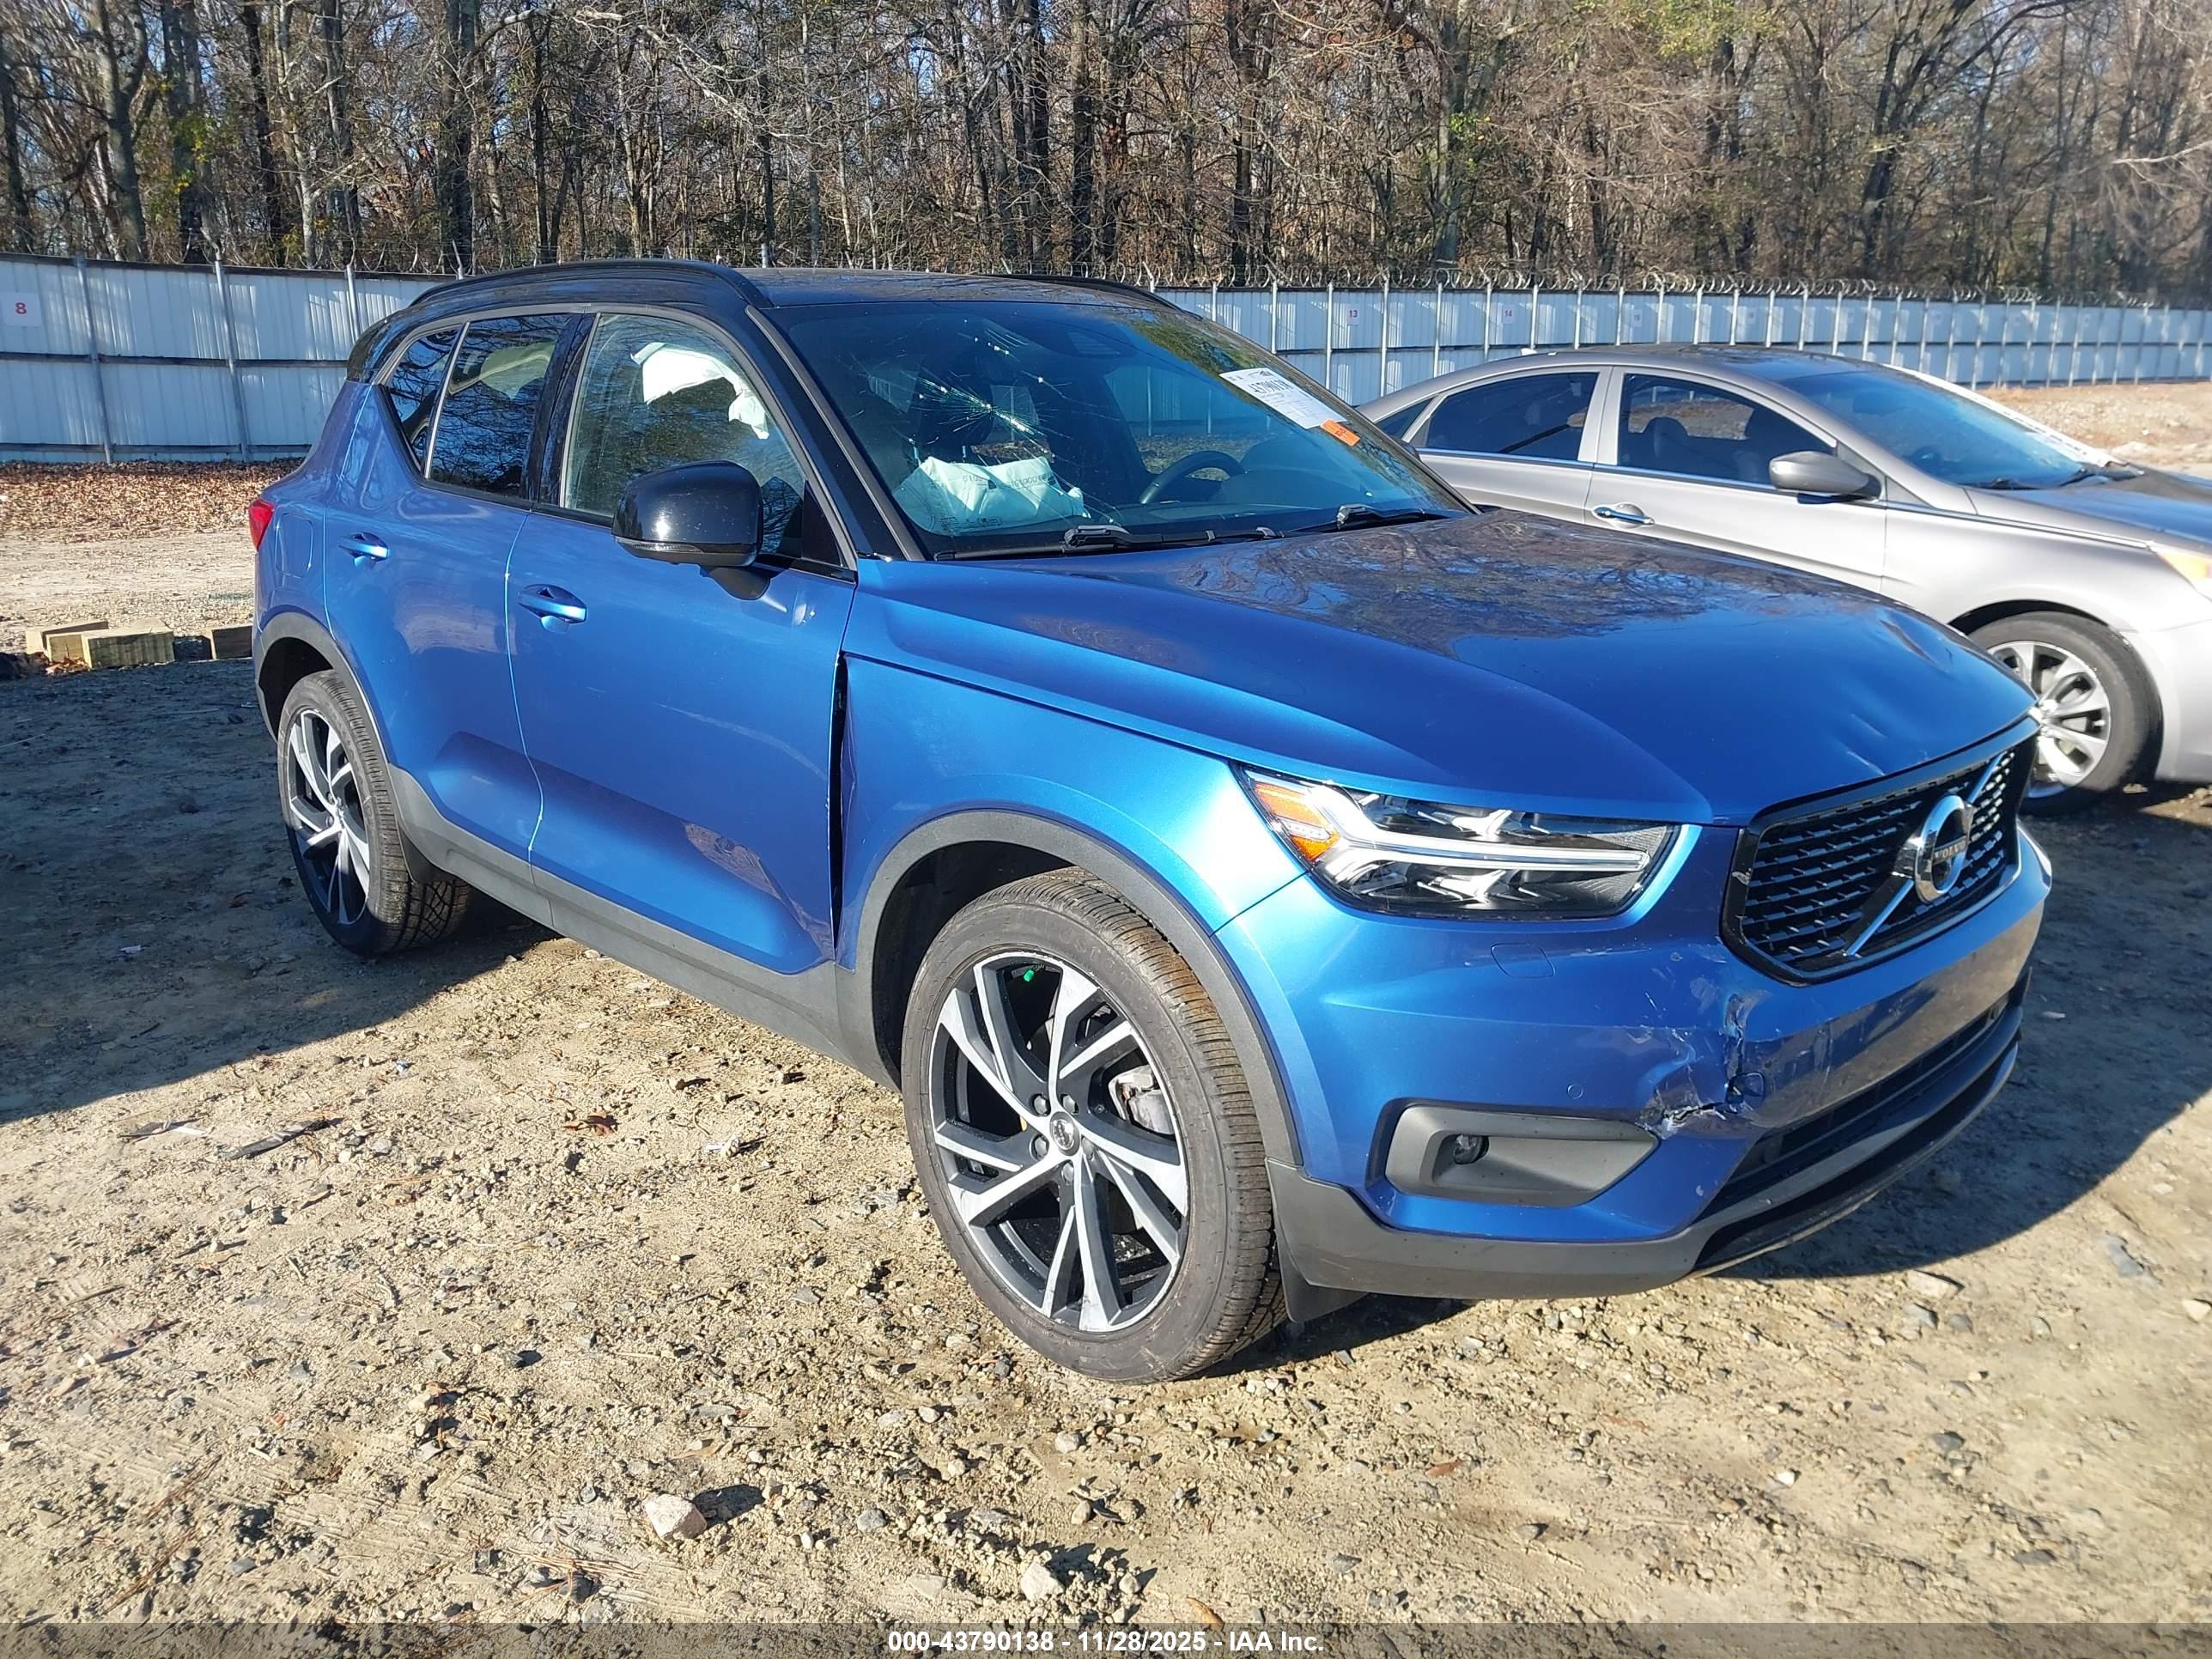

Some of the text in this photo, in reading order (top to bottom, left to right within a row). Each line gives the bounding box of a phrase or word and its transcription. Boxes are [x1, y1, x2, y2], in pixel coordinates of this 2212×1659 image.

[15, 302, 27, 315] 8
[1349, 309, 1358, 318] 13
[1934, 841, 1966, 859] VOLVO
